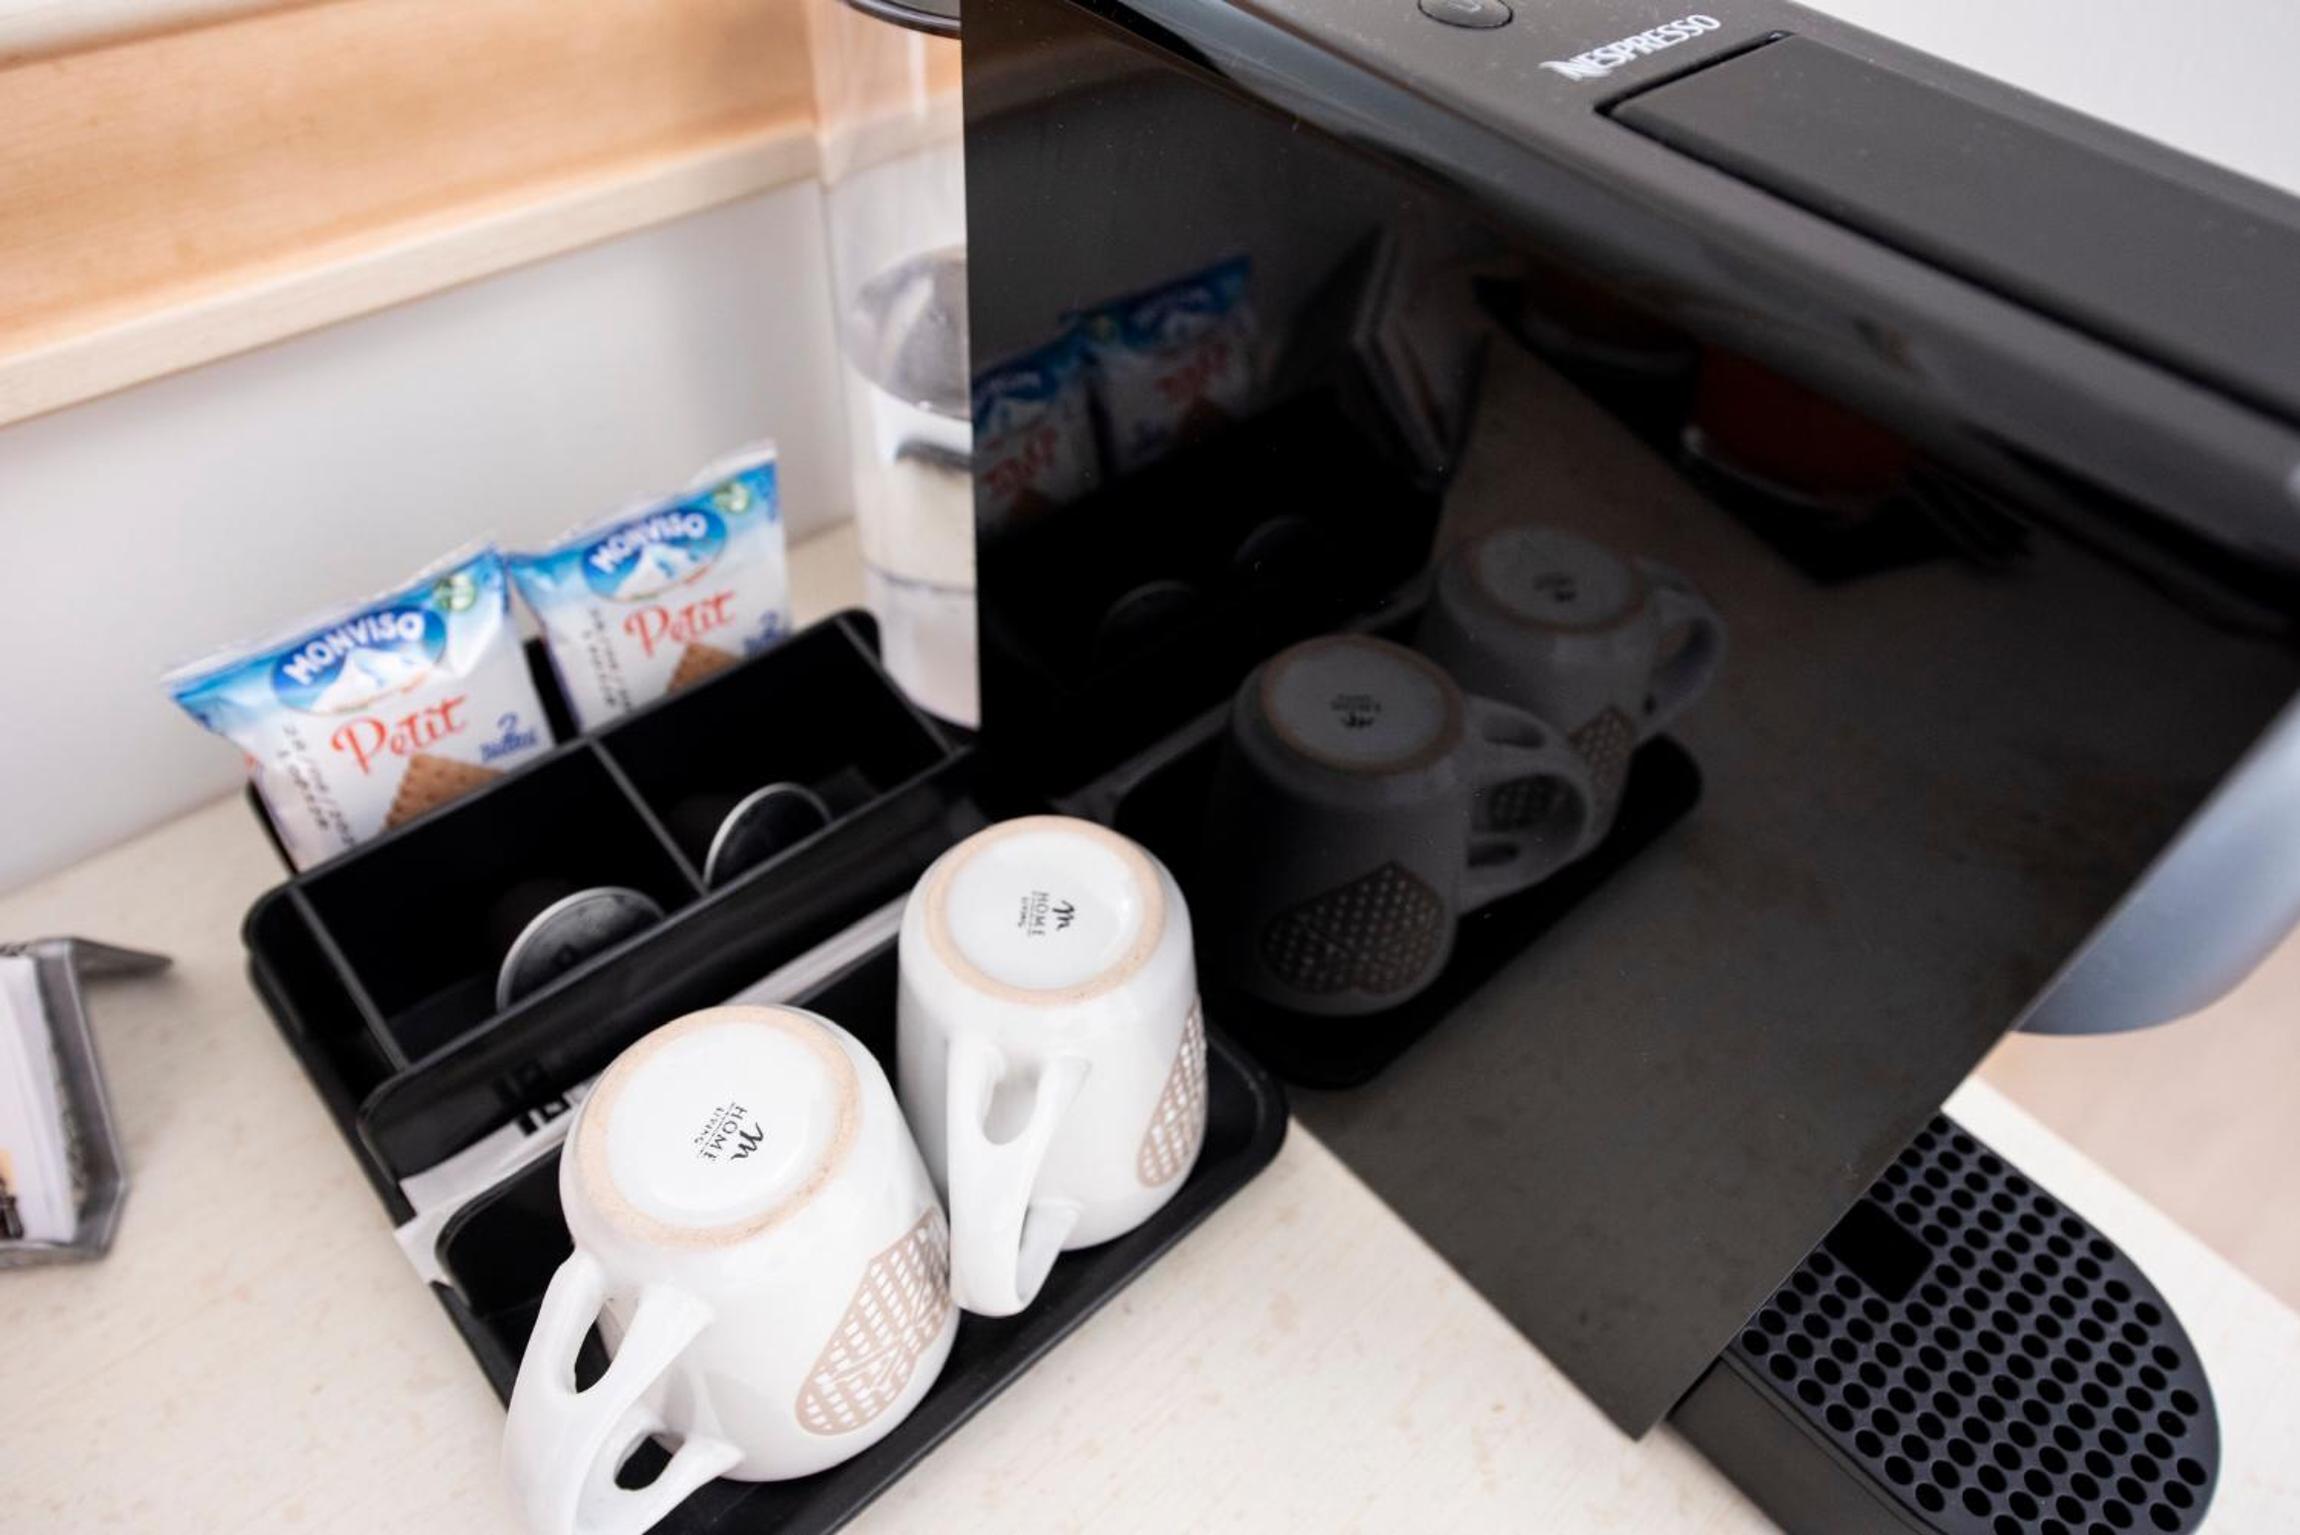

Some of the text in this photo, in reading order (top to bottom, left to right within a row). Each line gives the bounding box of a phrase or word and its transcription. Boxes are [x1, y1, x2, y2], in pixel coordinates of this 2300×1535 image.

[1538, 14, 1721, 81] NESPRESSO
[588, 512, 709, 574] MONVISO
[282, 611, 426, 686] MONVISO
[622, 590, 735, 658] Petit
[330, 693, 470, 776] Petit
[703, 1106, 748, 1161] HOME
